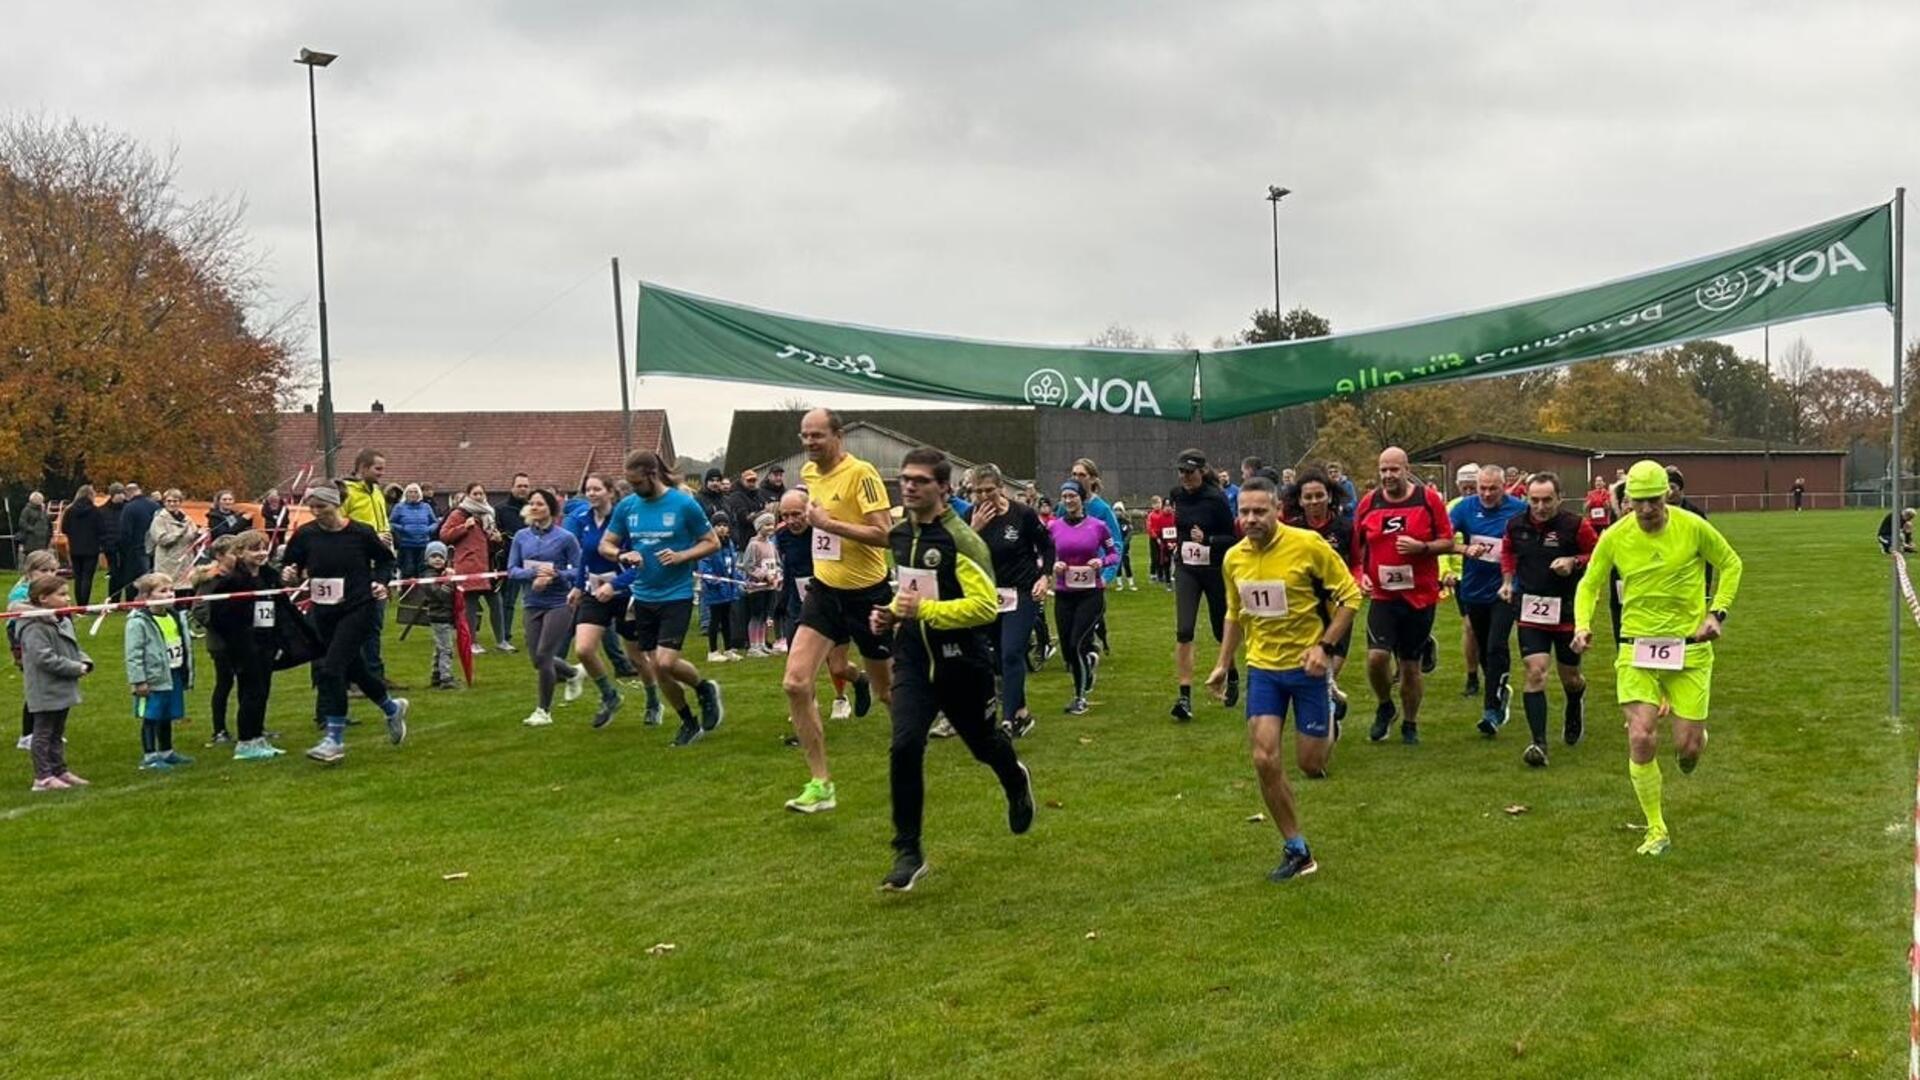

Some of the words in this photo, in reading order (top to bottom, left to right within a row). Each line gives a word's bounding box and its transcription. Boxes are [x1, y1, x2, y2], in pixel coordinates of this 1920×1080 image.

[816, 535, 831, 551] 32
[1188, 547, 1201, 559] 14
[1073, 571, 1088, 582] 25
[1386, 571, 1403, 583] 23
[317, 584, 332, 597] 31
[1251, 590, 1270, 607] 11
[1531, 602, 1550, 616] 22
[1649, 644, 1671, 660] 16
